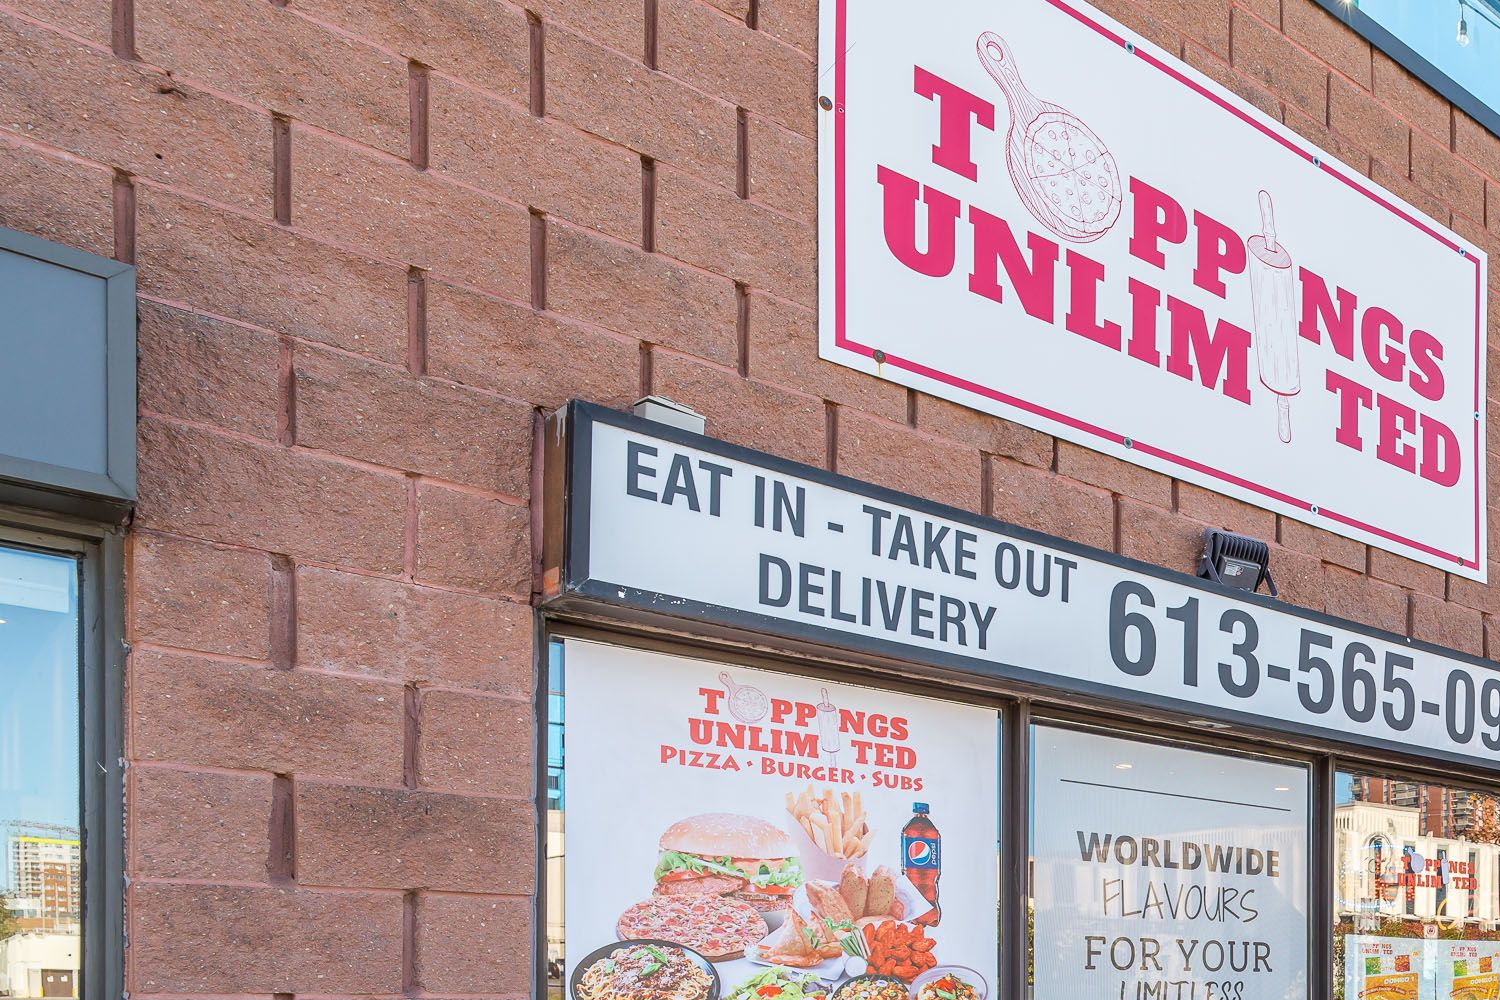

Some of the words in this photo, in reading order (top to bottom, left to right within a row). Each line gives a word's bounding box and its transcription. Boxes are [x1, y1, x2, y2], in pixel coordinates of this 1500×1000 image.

[626, 440, 733, 518] EAT
[754, 474, 806, 538] IN
[862, 503, 978, 581] TAKE
[994, 541, 1078, 603] OUT
[759, 552, 998, 651] DELIVERY
[1077, 830, 1280, 878] WORLDWIDE
[1103, 878, 1258, 923] FLAVOURS
[1085, 936, 1163, 971] FOR
[1175, 939, 1273, 972] YOUR
